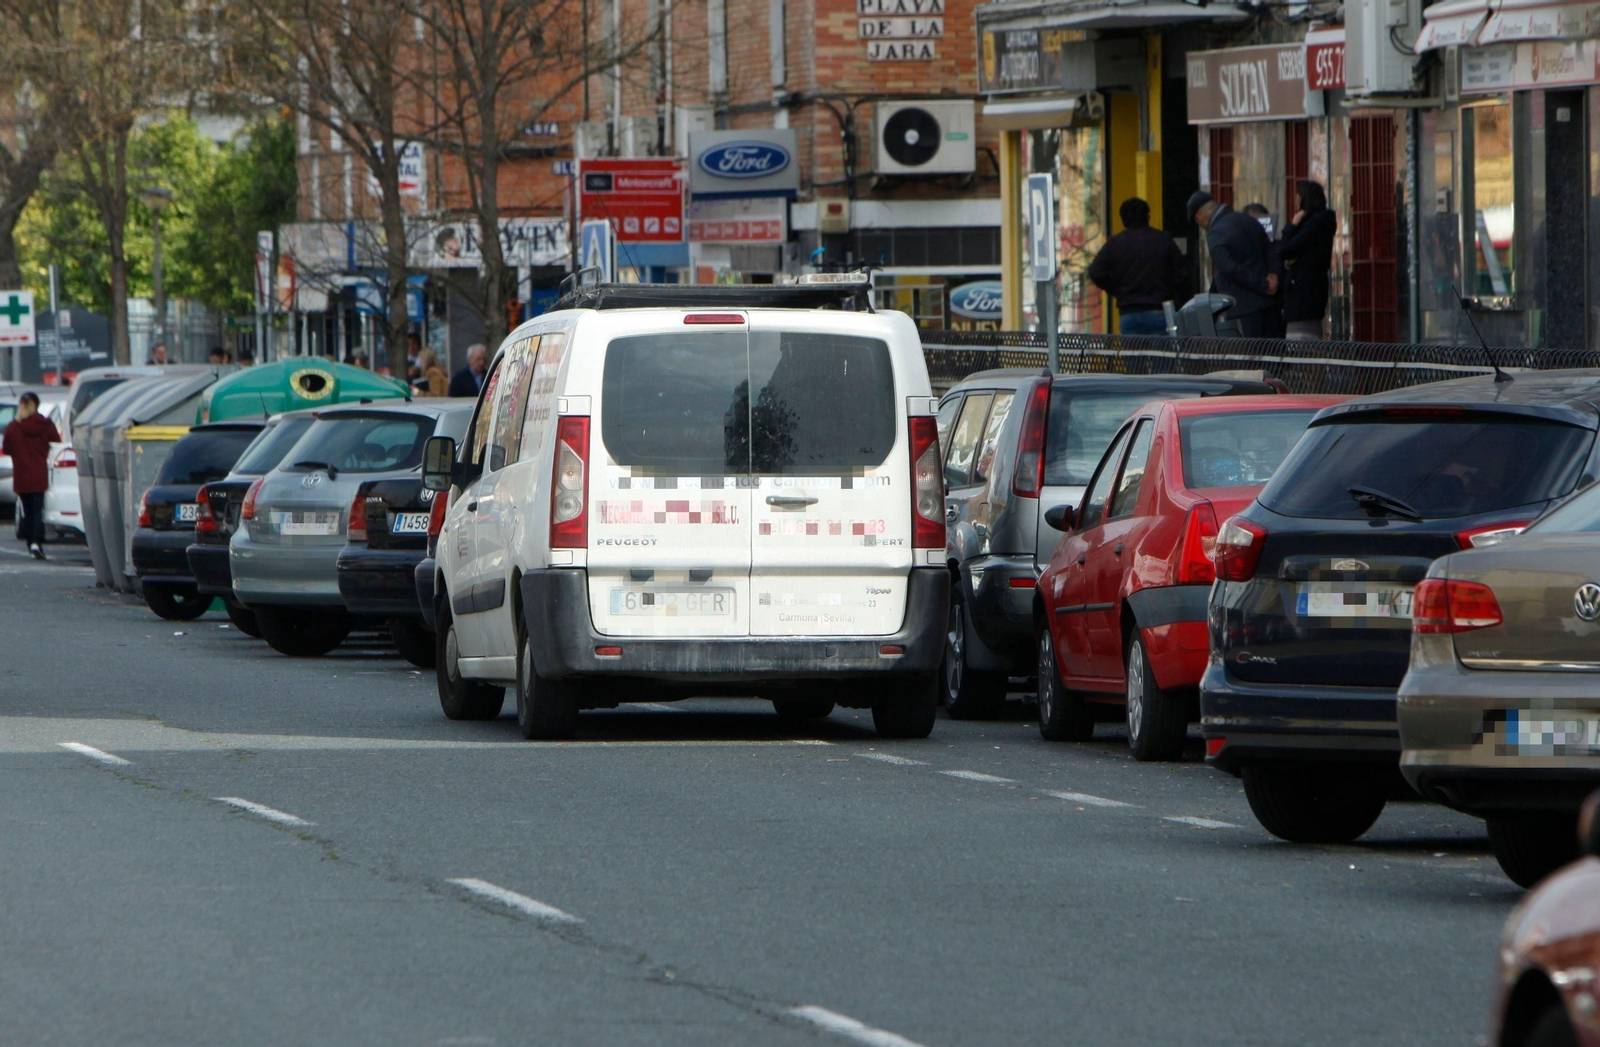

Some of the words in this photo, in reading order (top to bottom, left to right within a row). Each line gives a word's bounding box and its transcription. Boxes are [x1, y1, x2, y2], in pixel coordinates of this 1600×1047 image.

[860, 0, 942, 12] PLAYA
[862, 21, 892, 36] DE
[910, 20, 940, 36] LA
[869, 43, 932, 58] JARA
[1316, 48, 1334, 86] 955
[1219, 59, 1270, 117] SULTAN
[719, 148, 772, 171] Ford
[618, 176, 673, 188] Motorcraft
[1032, 189, 1046, 267] P
[402, 514, 430, 530] 1458
[597, 538, 658, 546] PEUGEOT
[779, 612, 818, 622] Carmona
[820, 612, 856, 624] (Sevilla)
